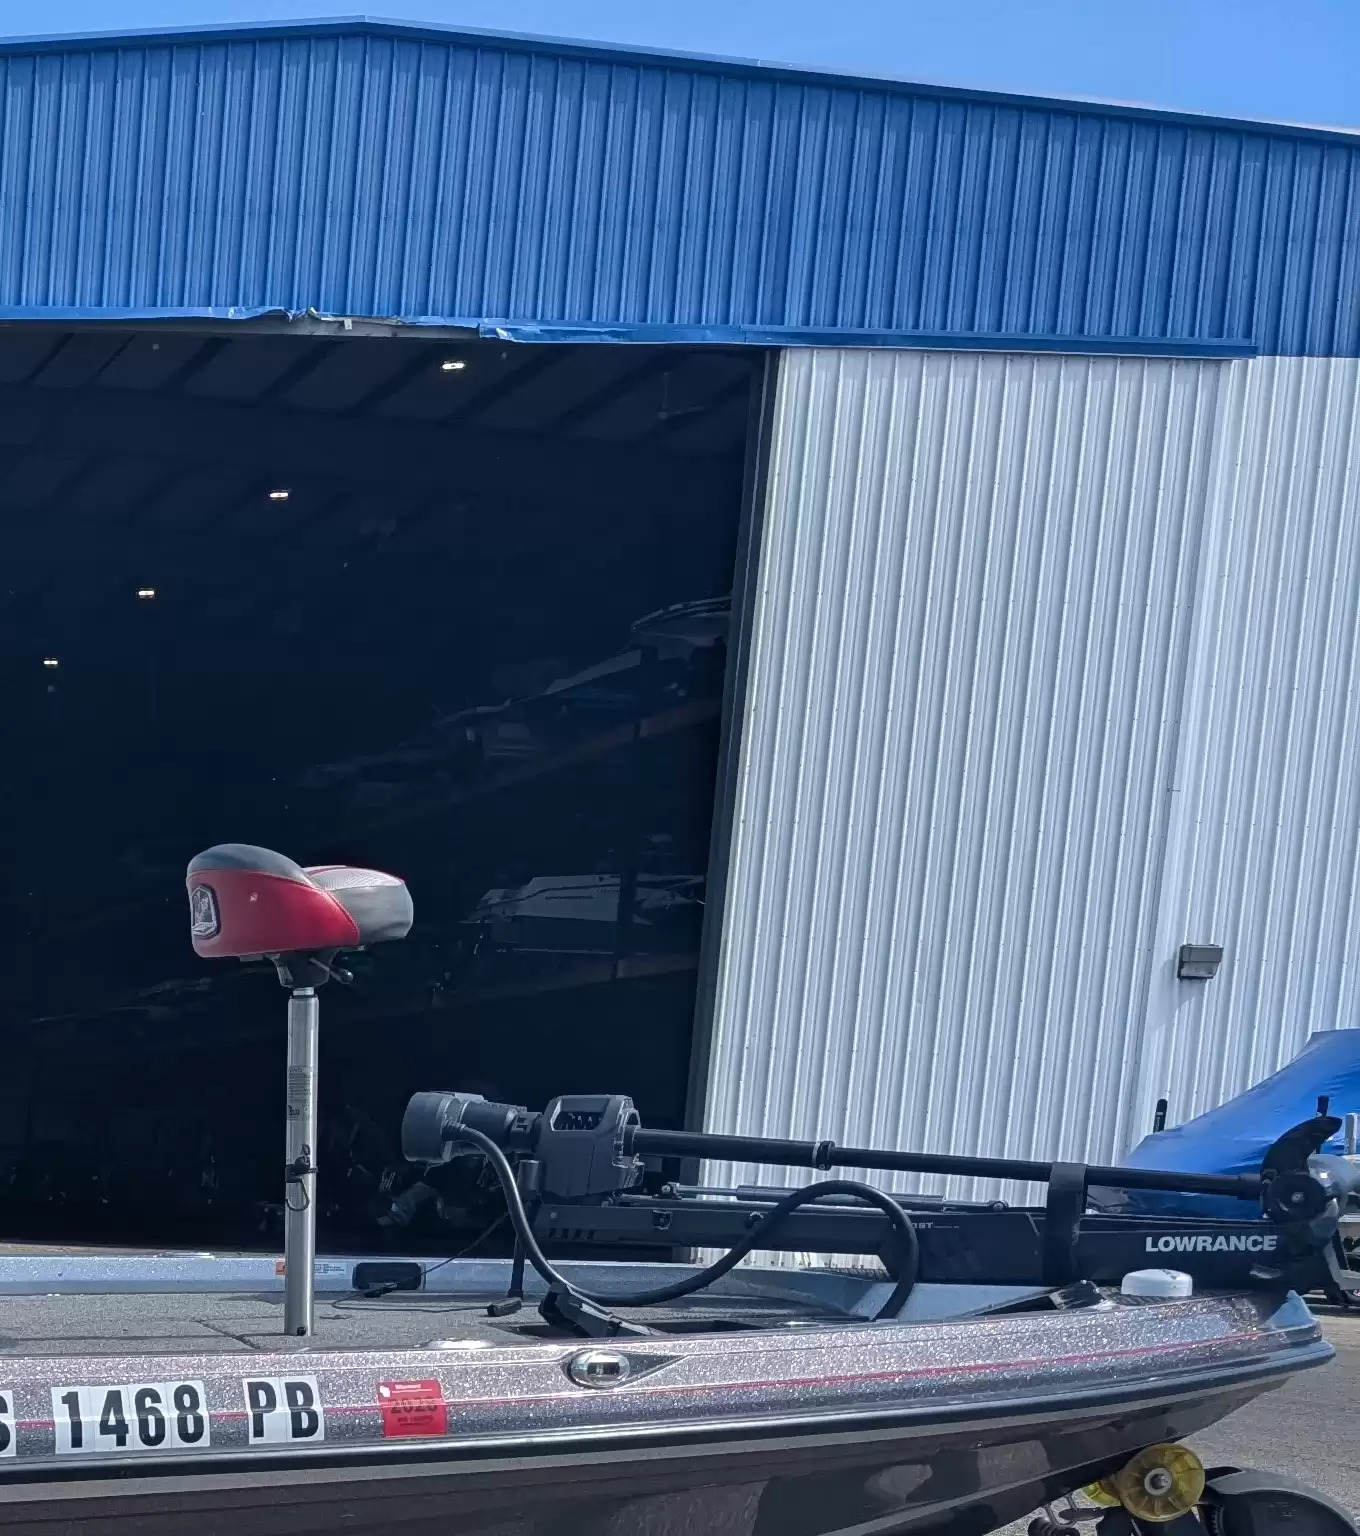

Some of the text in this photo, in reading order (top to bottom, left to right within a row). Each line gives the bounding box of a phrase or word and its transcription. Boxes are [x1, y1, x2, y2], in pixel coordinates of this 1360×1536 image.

[1145, 1234, 1278, 1252] LOWRANCE
[61, 1384, 205, 1449] 1468
[247, 1381, 320, 1439] PB
